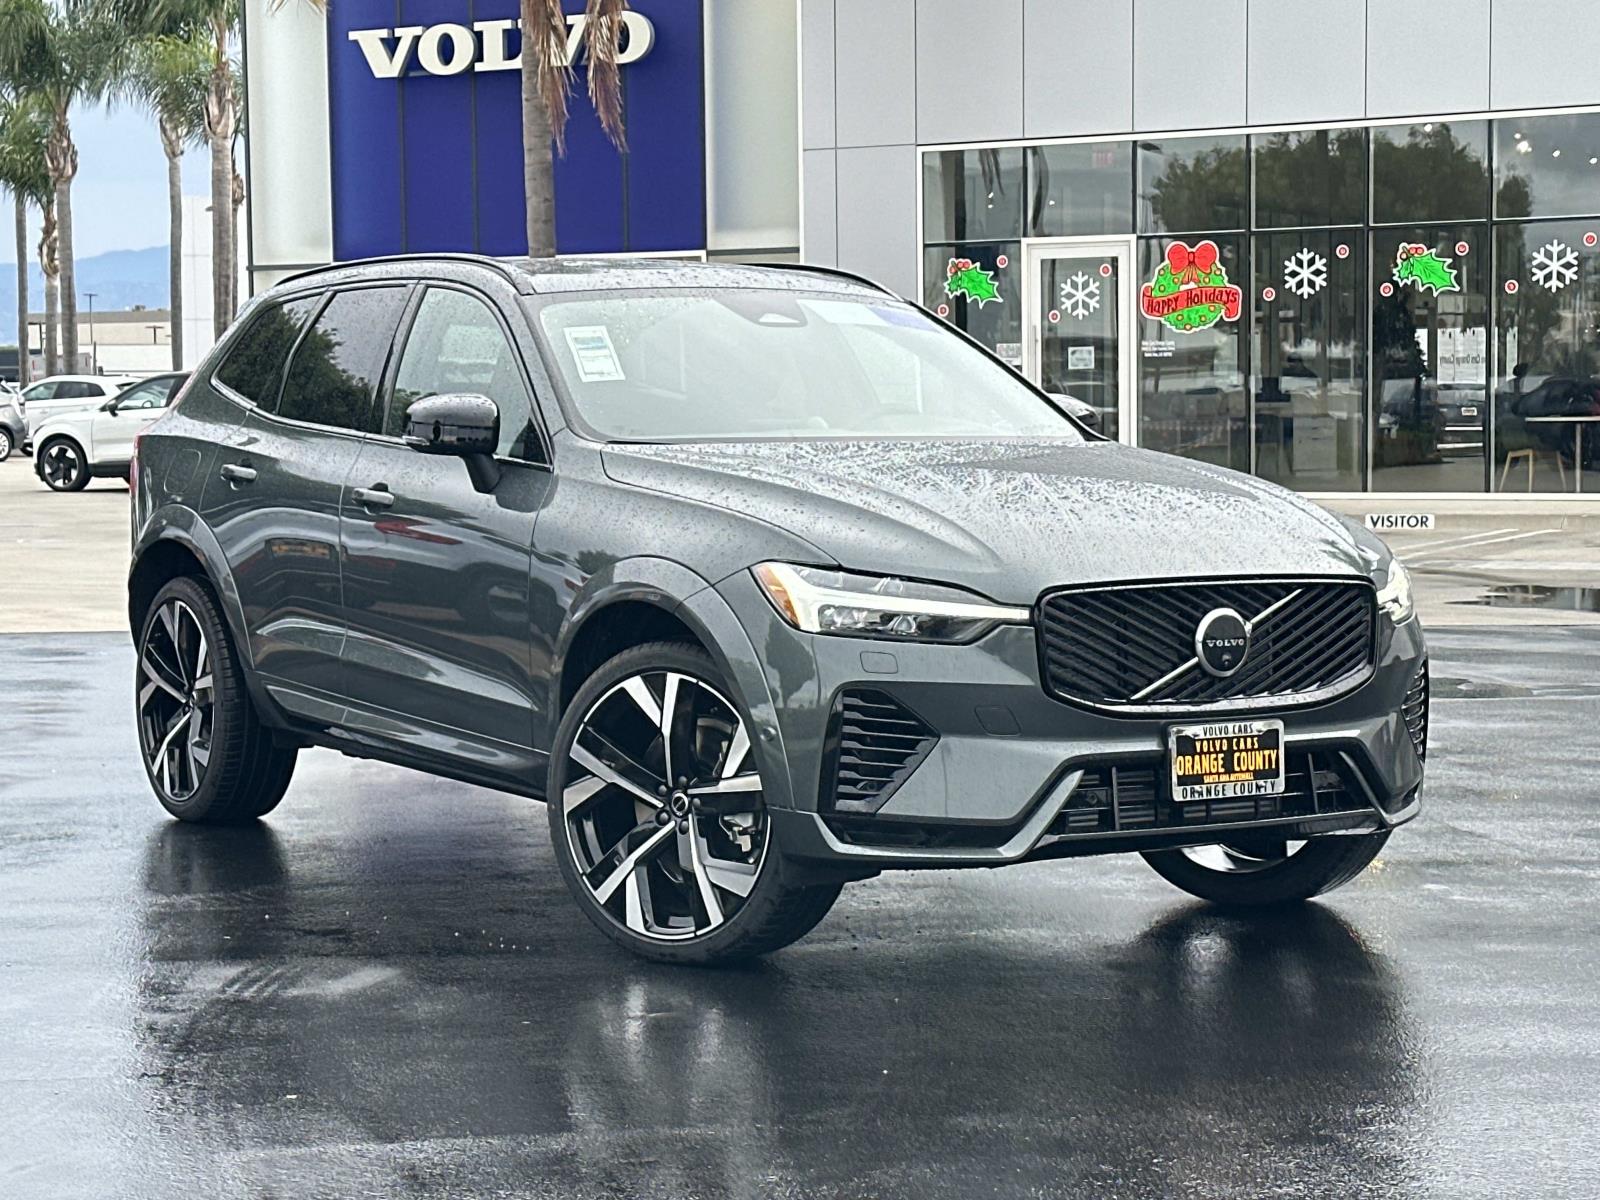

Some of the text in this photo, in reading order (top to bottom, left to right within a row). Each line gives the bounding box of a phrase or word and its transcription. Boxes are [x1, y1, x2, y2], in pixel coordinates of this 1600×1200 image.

[1186, 288, 1238, 307] Holidays
[1370, 515, 1429, 528] VISITOR
[1206, 639, 1245, 647] VOLVO
[1203, 723, 1253, 737] VOLVO CARS
[1195, 737, 1259, 753] VOLVO CARS
[1176, 749, 1277, 775] ORANGE COUNTY
[1181, 780, 1276, 800] ORANGE COUNTY
